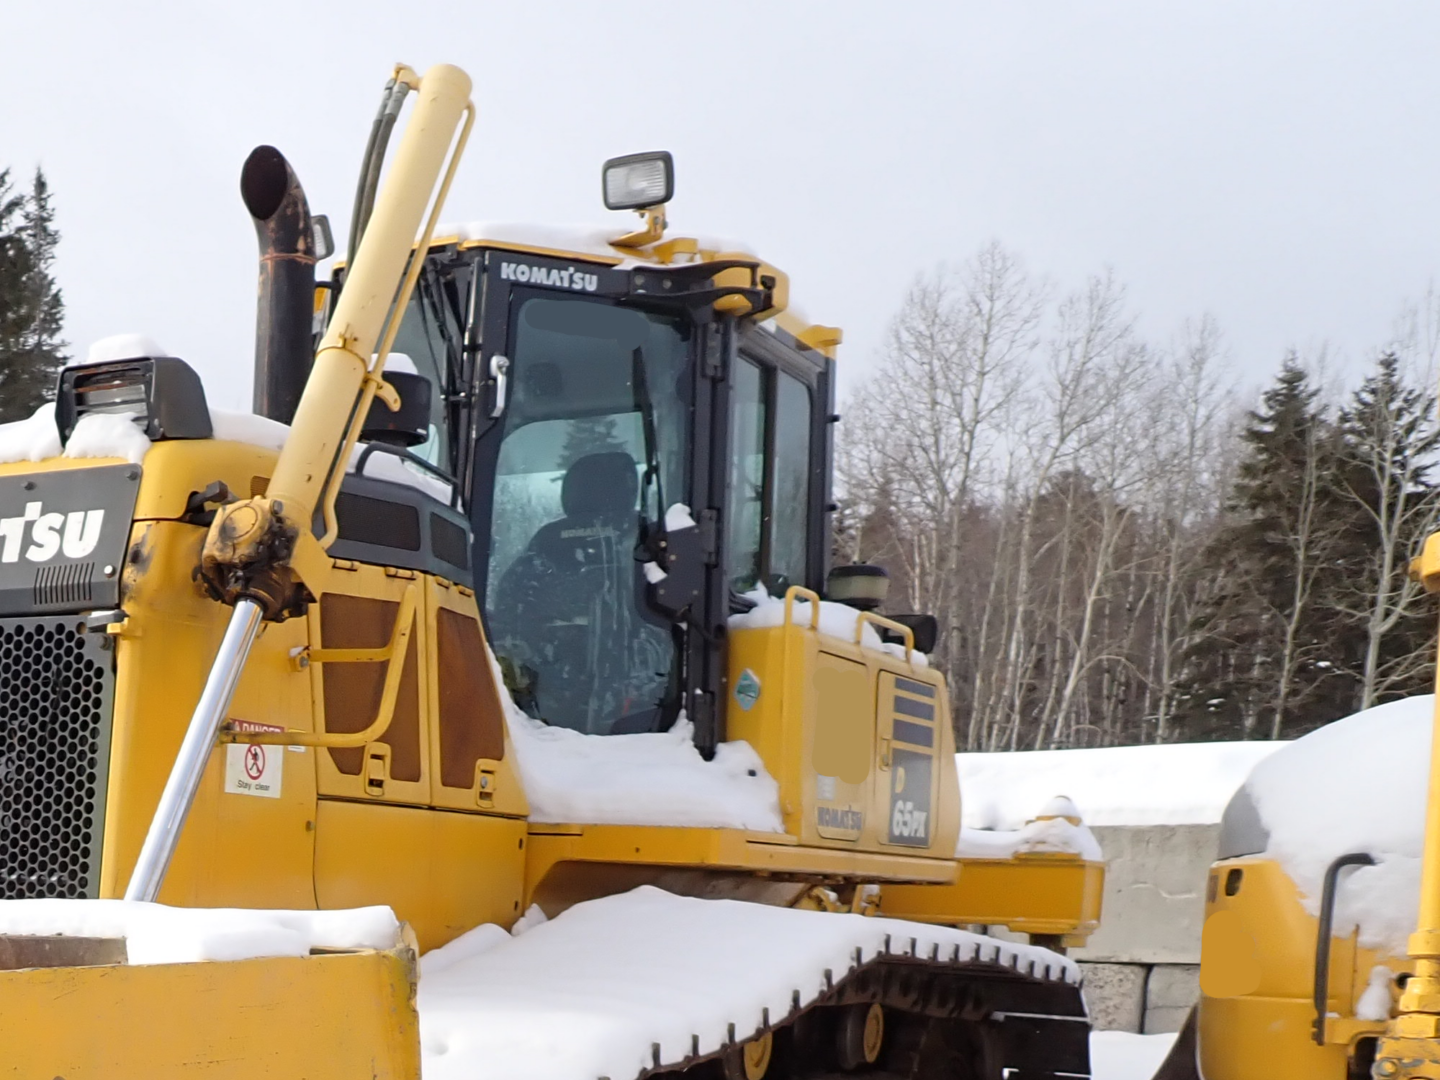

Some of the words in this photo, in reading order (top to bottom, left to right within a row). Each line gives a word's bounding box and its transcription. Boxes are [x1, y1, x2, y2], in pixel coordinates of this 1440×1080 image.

[500, 262, 598, 292] KOMATSU
[237, 780, 252, 791] Stay
[255, 783, 270, 792] clear
